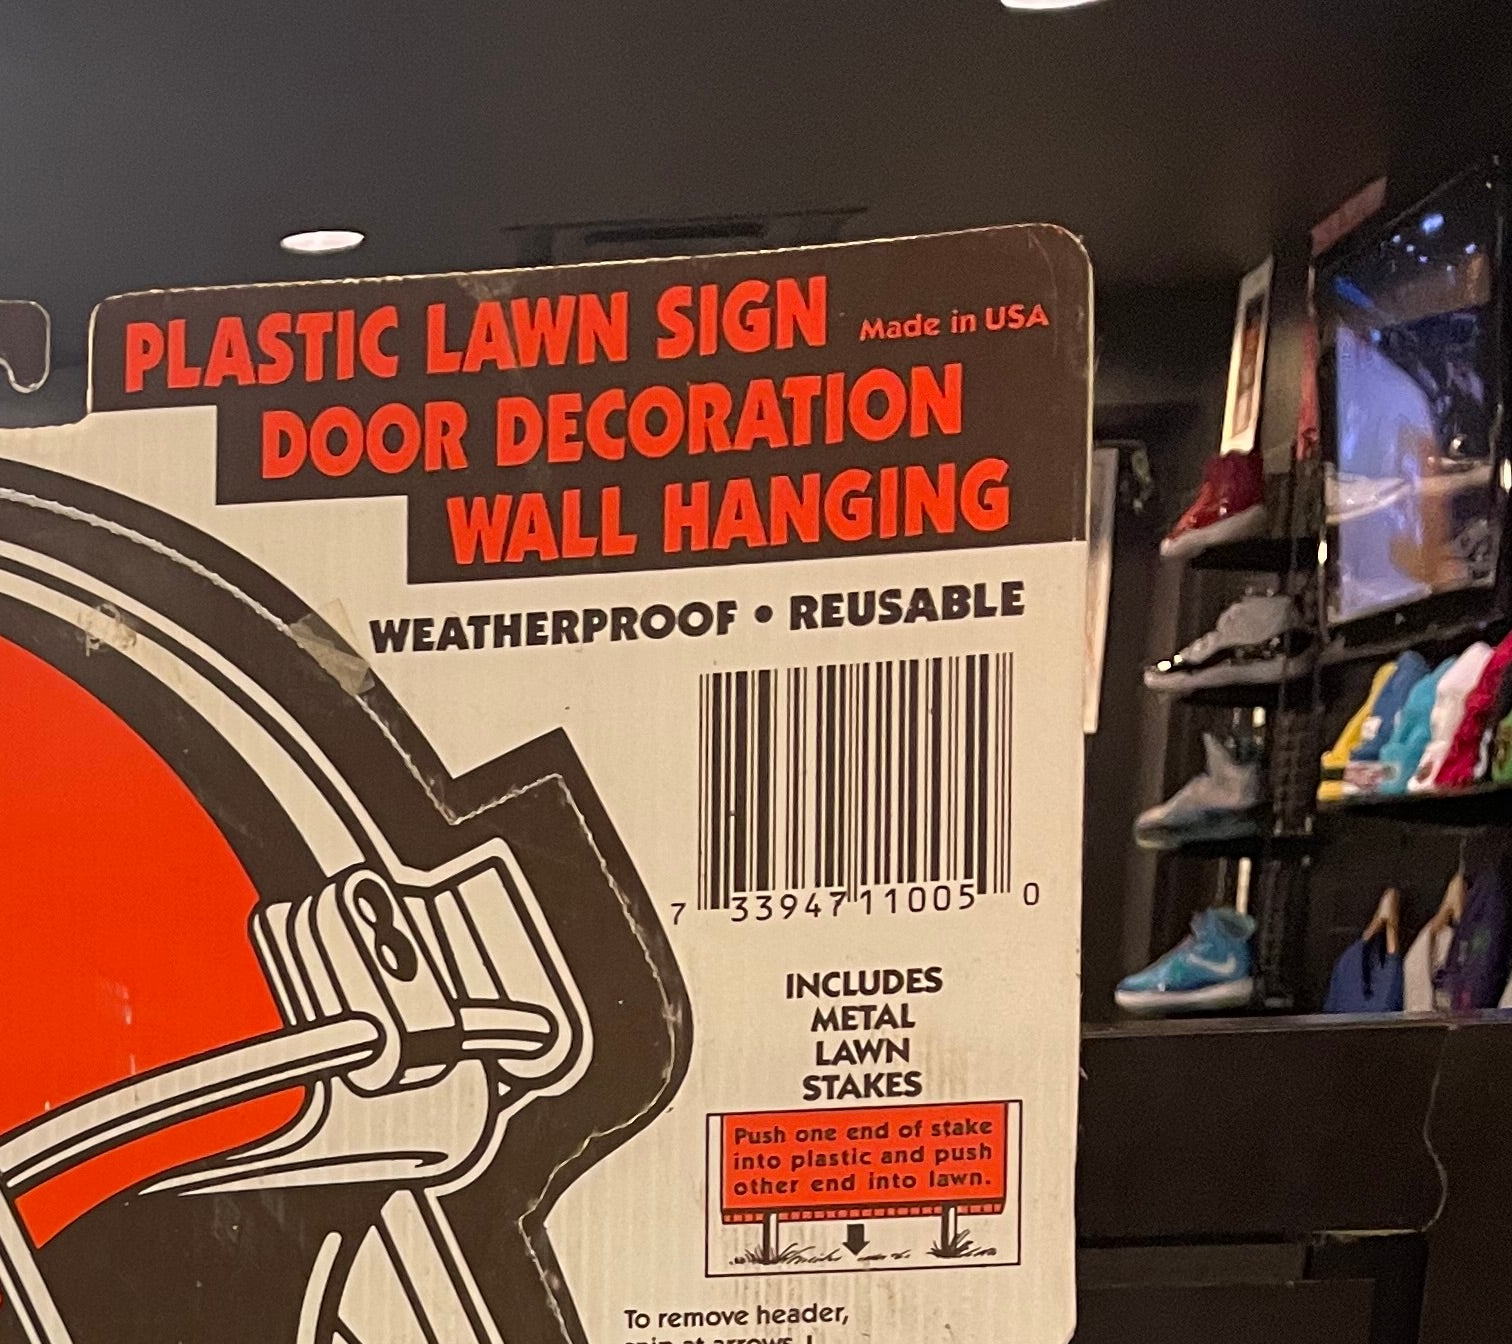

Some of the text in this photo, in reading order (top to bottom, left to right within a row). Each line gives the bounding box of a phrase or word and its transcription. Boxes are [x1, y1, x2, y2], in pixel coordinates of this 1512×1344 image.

[125, 275, 828, 394] PLASTIC LAWN SIGN
[859, 303, 1050, 341] Made in USA
[262, 362, 963, 480] DOOR DECORATION
[445, 456, 1011, 566] WALL HANGING
[370, 580, 1026, 654] WEATHERPROOF REUSABLE
[786, 966, 944, 999] INCLUDES
[810, 1002, 917, 1032] METAL
[815, 1037, 911, 1066] LAWN
[801, 1070, 923, 1101] STAKES
[734, 1118, 993, 1145] Push one end of stake
[733, 1142, 993, 1179] into plastic and push
[733, 1169, 992, 1196] other end into lawn.
[623, 1302, 849, 1329] To remove header,
